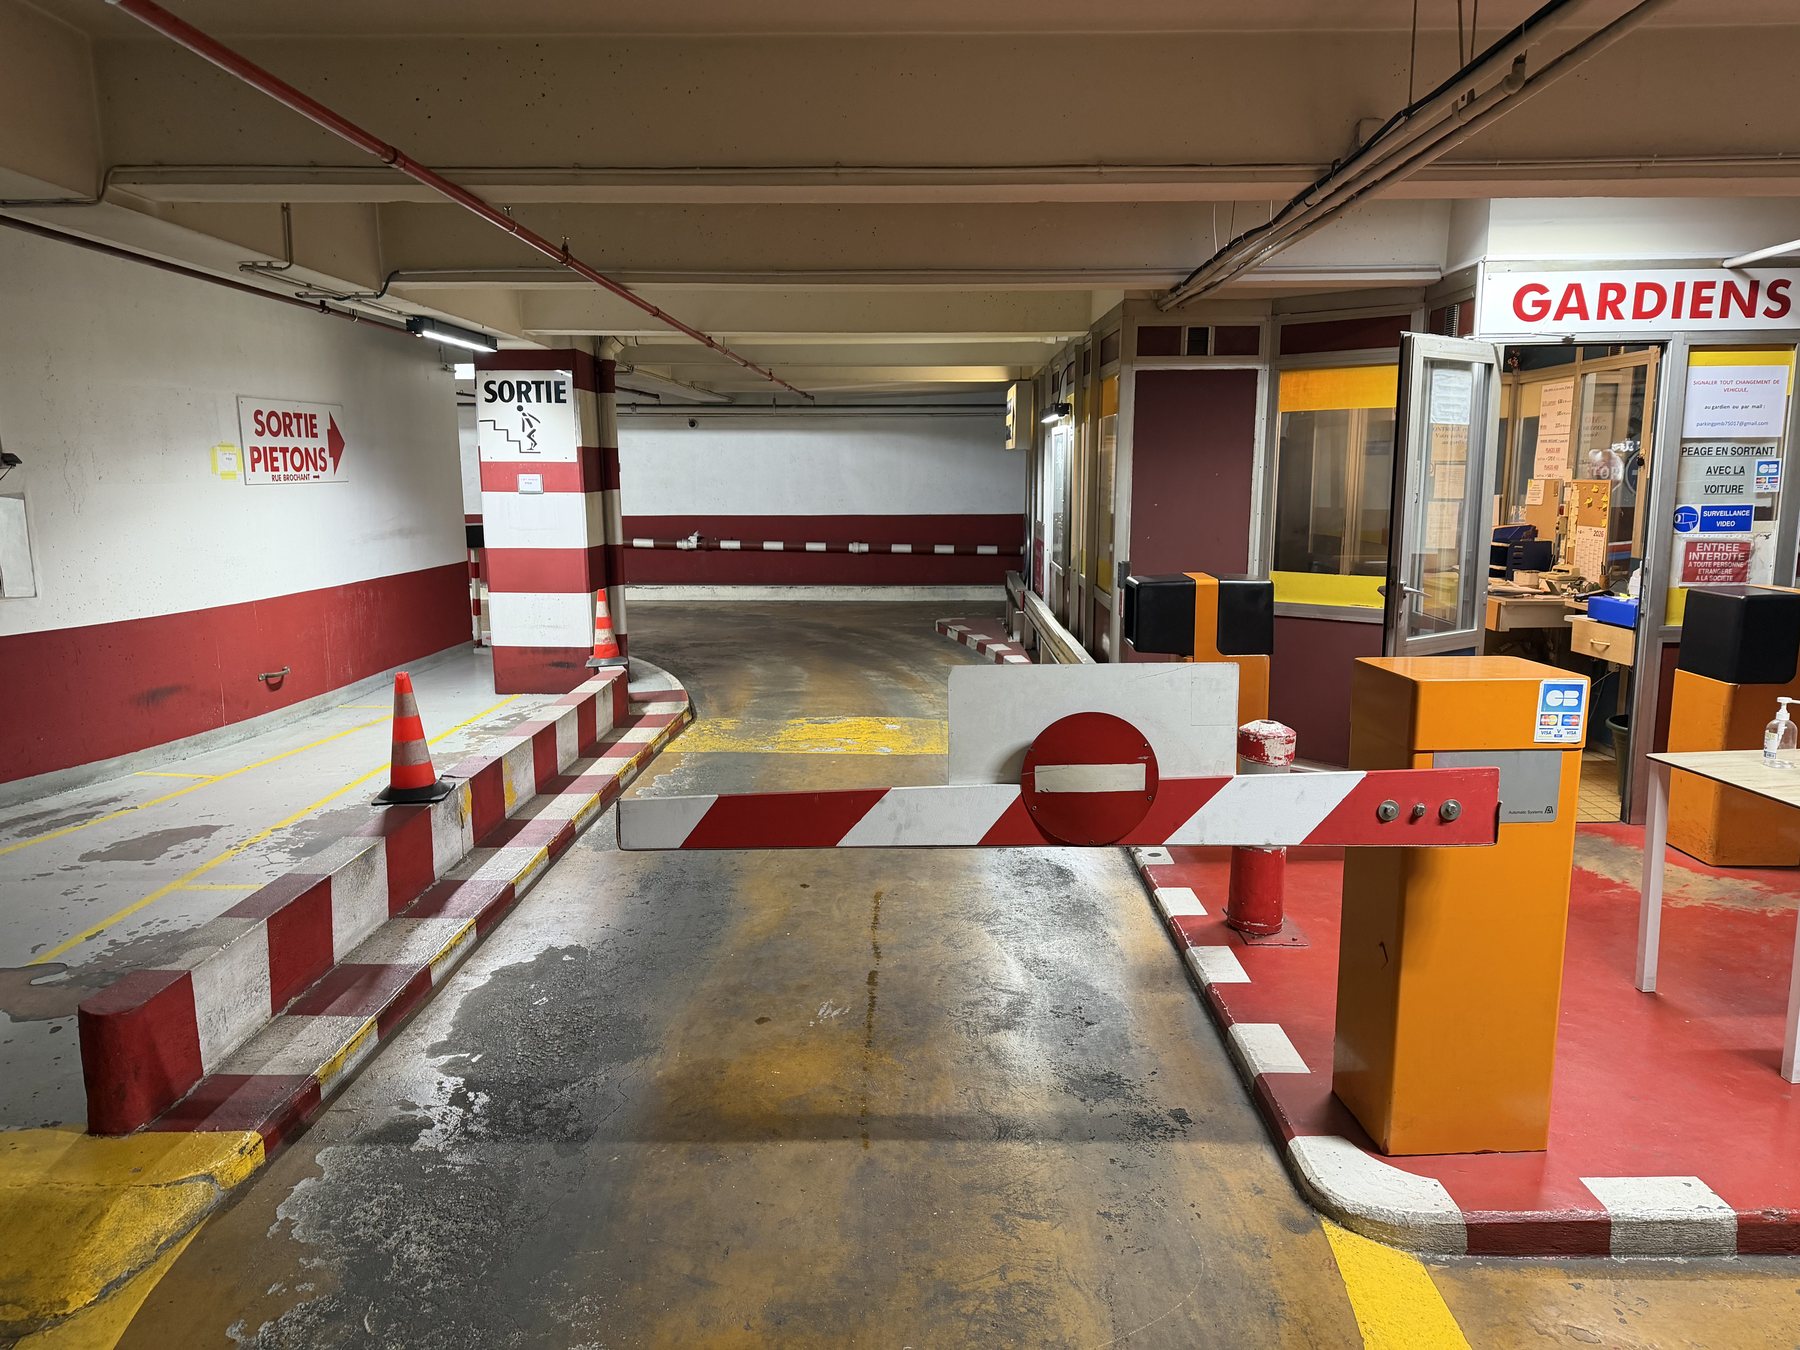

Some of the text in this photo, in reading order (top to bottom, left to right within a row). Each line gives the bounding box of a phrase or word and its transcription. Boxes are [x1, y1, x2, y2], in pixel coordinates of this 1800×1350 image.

[1513, 279, 1792, 322] GARDIENS
[484, 380, 567, 403] SORTIE
[253, 409, 318, 438] SORTIE
[1681, 446, 1775, 456] PEAGE EN SORTANT
[249, 446, 327, 472] PIETONS
[1706, 466, 1745, 475] AVEC LA
[272, 474, 282, 482] RUE
[1704, 485, 1744, 493] VOITURE
[1696, 543, 1740, 551] ENTREE
[1689, 552, 1745, 560] INTERDITE
[1546, 690, 1579, 706] CB
